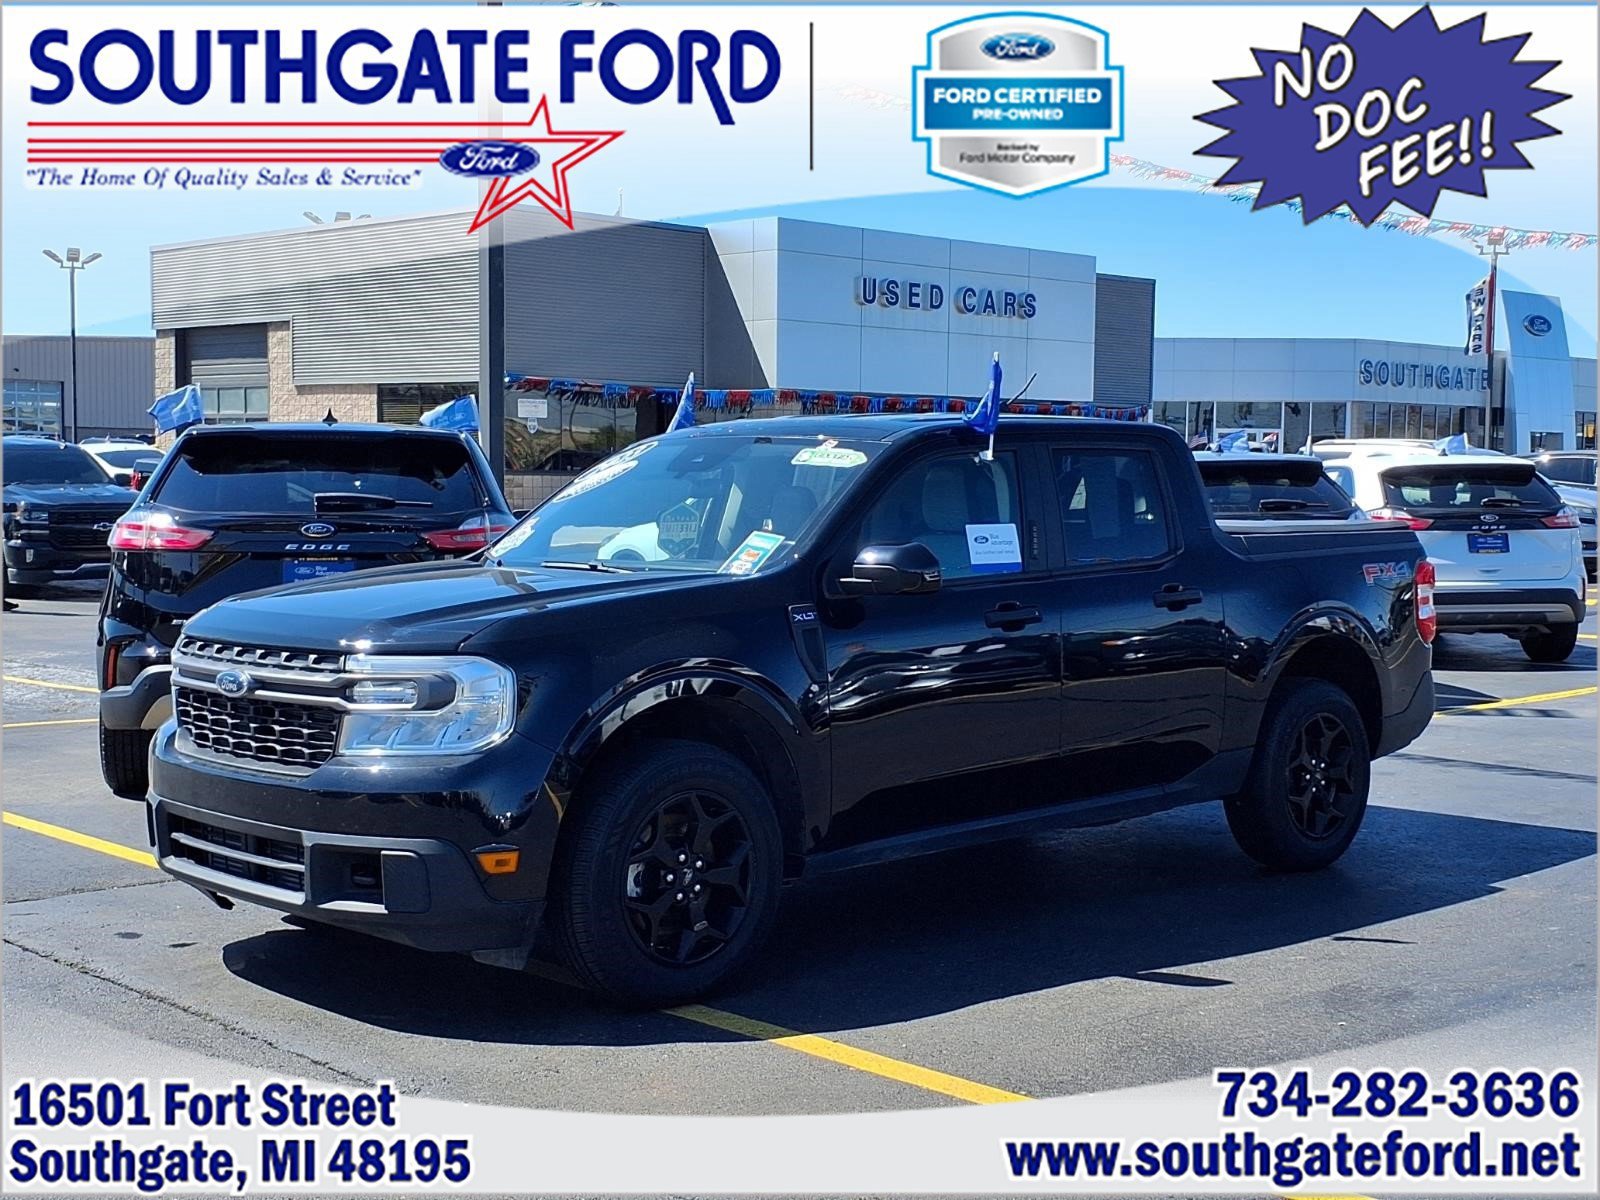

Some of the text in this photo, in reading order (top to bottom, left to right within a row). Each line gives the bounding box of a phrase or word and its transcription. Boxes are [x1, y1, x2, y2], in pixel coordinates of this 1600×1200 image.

[859, 275, 1037, 319] USED CARS
[1360, 358, 1490, 391] SOUTHGATE
[284, 542, 352, 551] EDGE
[1362, 560, 1411, 586] FX4
[792, 611, 817, 622] XLT
